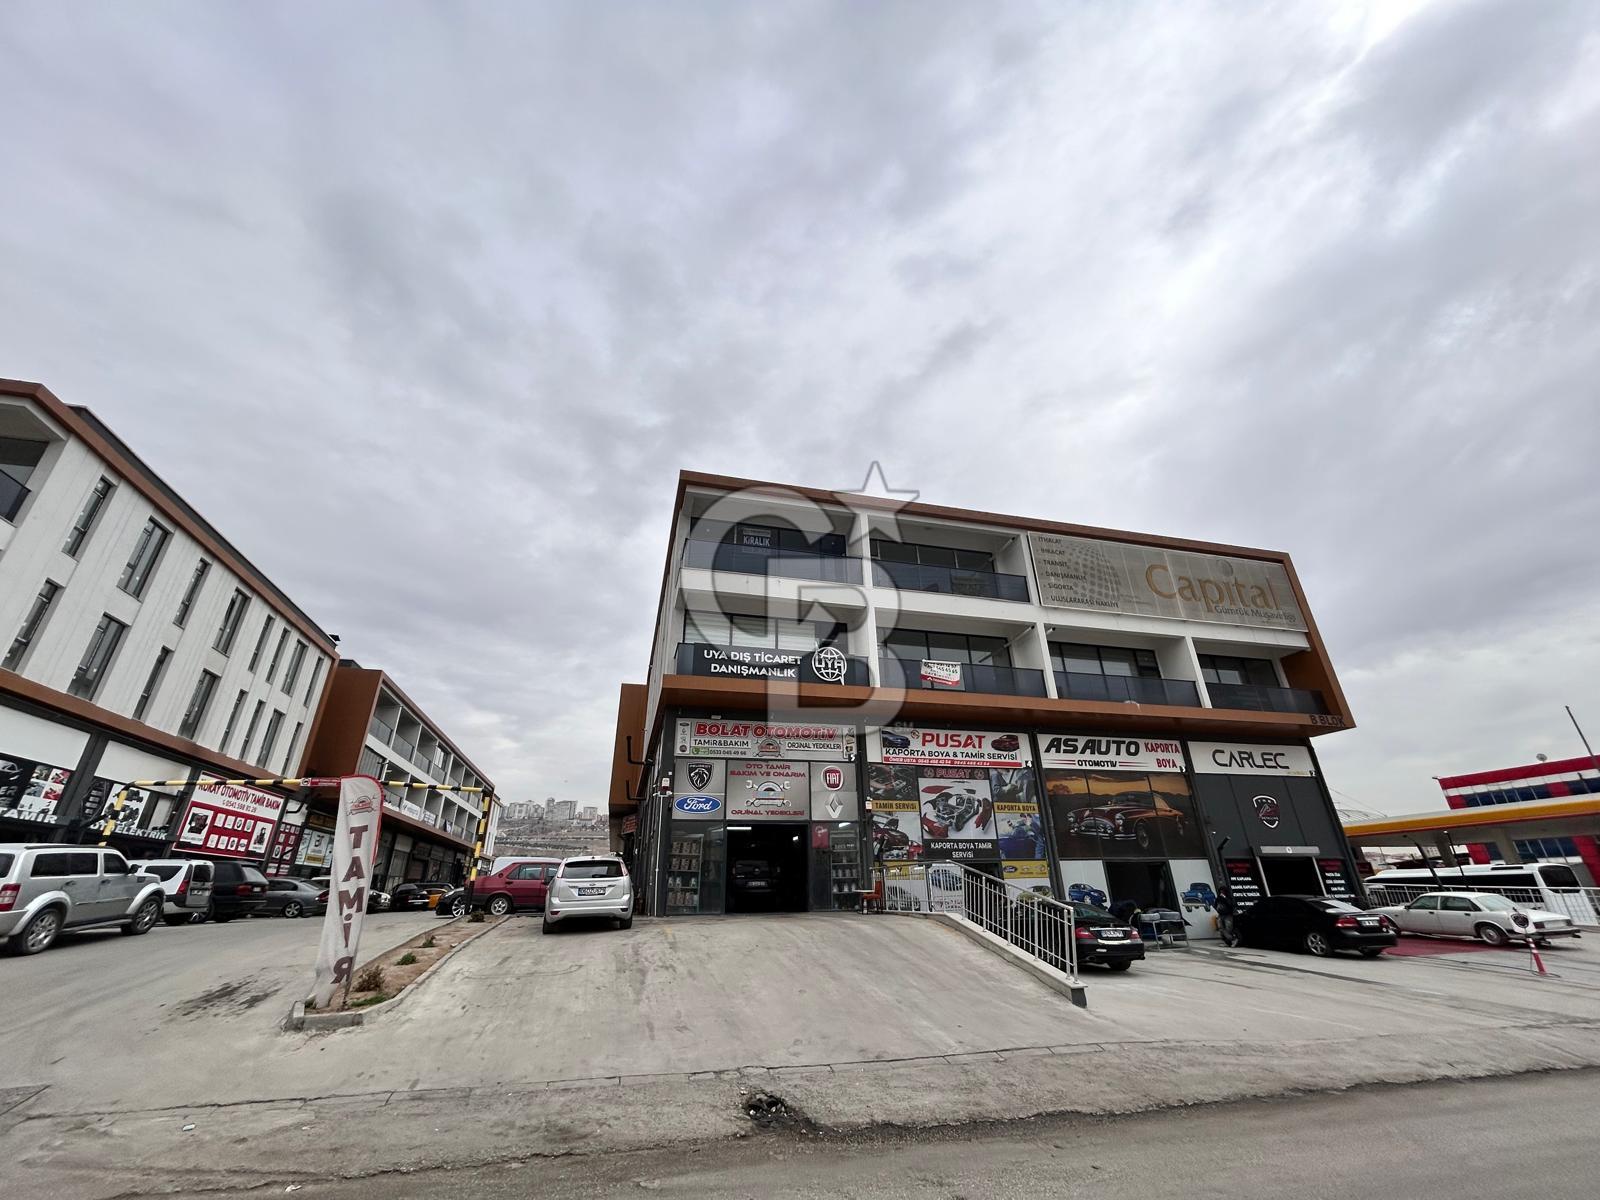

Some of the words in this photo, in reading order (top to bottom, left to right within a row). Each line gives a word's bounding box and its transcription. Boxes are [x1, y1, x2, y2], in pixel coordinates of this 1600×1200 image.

[1145, 561, 1281, 613] Capital
[704, 649, 728, 659] UYA
[730, 651, 751, 662] DIŞ
[753, 650, 802, 665] TİCARET
[710, 663, 796, 678] DANIŞMANLIK
[694, 721, 752, 738] BOLAT
[921, 732, 986, 749] PUSAT
[885, 748, 926, 757] KAPORTA
[927, 750, 951, 758] BOYA
[1144, 741, 1181, 754] KAPORTA
[1155, 757, 1178, 769] BOYA
[1211, 748, 1290, 770] CARLEC
[826, 772, 840, 785] FIAT
[936, 767, 971, 778] PUSAT
[683, 797, 713, 810] Ford
[930, 842, 957, 850] KAPORTA
[958, 842, 974, 850] BOYA
